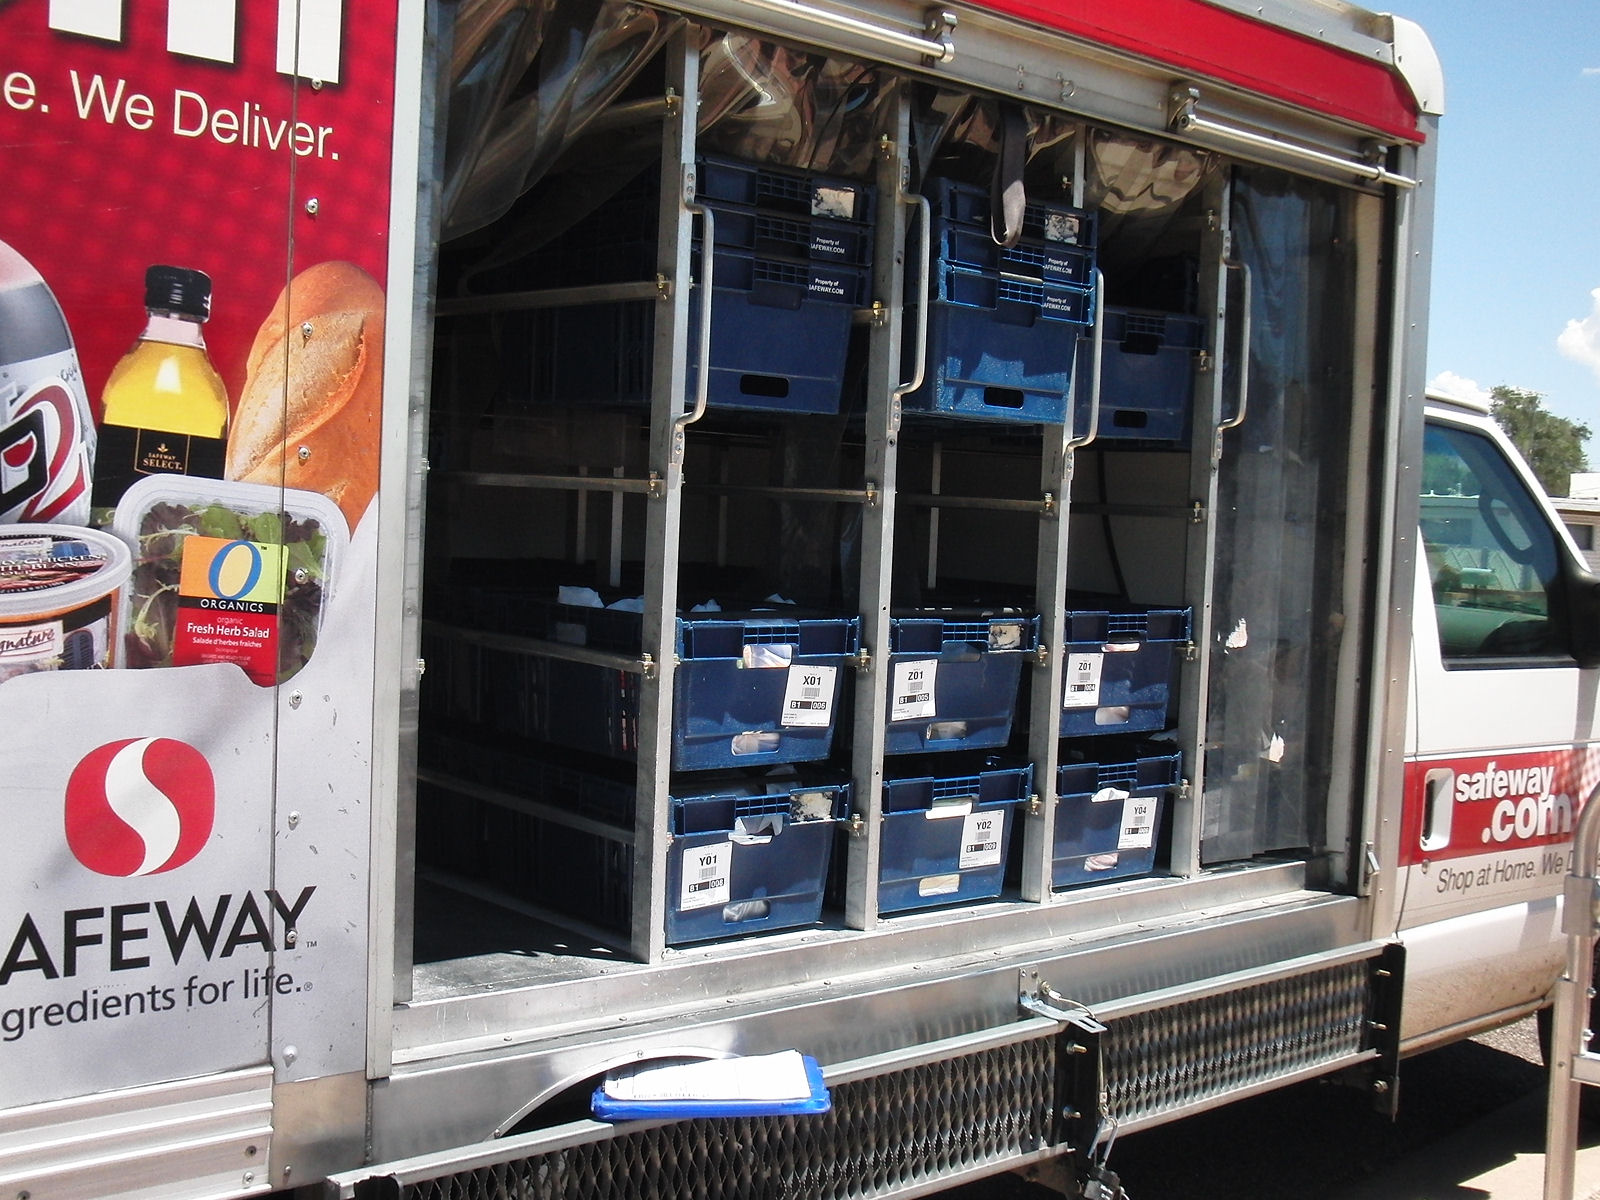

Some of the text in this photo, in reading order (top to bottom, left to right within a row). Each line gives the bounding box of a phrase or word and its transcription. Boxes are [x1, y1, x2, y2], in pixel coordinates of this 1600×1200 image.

[70, 69, 154, 130] We
[173, 89, 339, 160] Deliver.
[816, 237, 834, 246] Property
[815, 278, 833, 287] Property
[148, 452, 176, 460] SAFEWAY
[200, 598, 264, 613] ORGANICS
[216, 616, 243, 626] organic
[187, 622, 270, 639] Fresh Herb Salad
[192, 637, 212, 645] Salade
[1078, 662, 1091, 671] Z01
[803, 675, 821, 686] X01
[908, 671, 923, 681] Z01
[1455, 761, 1555, 803] safeway
[1134, 806, 1147, 815] Y04
[1481, 793, 1572, 844] .com
[976, 821, 992, 830] Y02
[699, 855, 717, 866] Y01
[1437, 868, 1474, 895] Shop
[1476, 867, 1491, 887] at
[1493, 859, 1537, 884] Home.
[1542, 852, 1563, 876] We
[0, 886, 317, 985] AFEWAY
[1, 965, 302, 1042] gredients for life.
